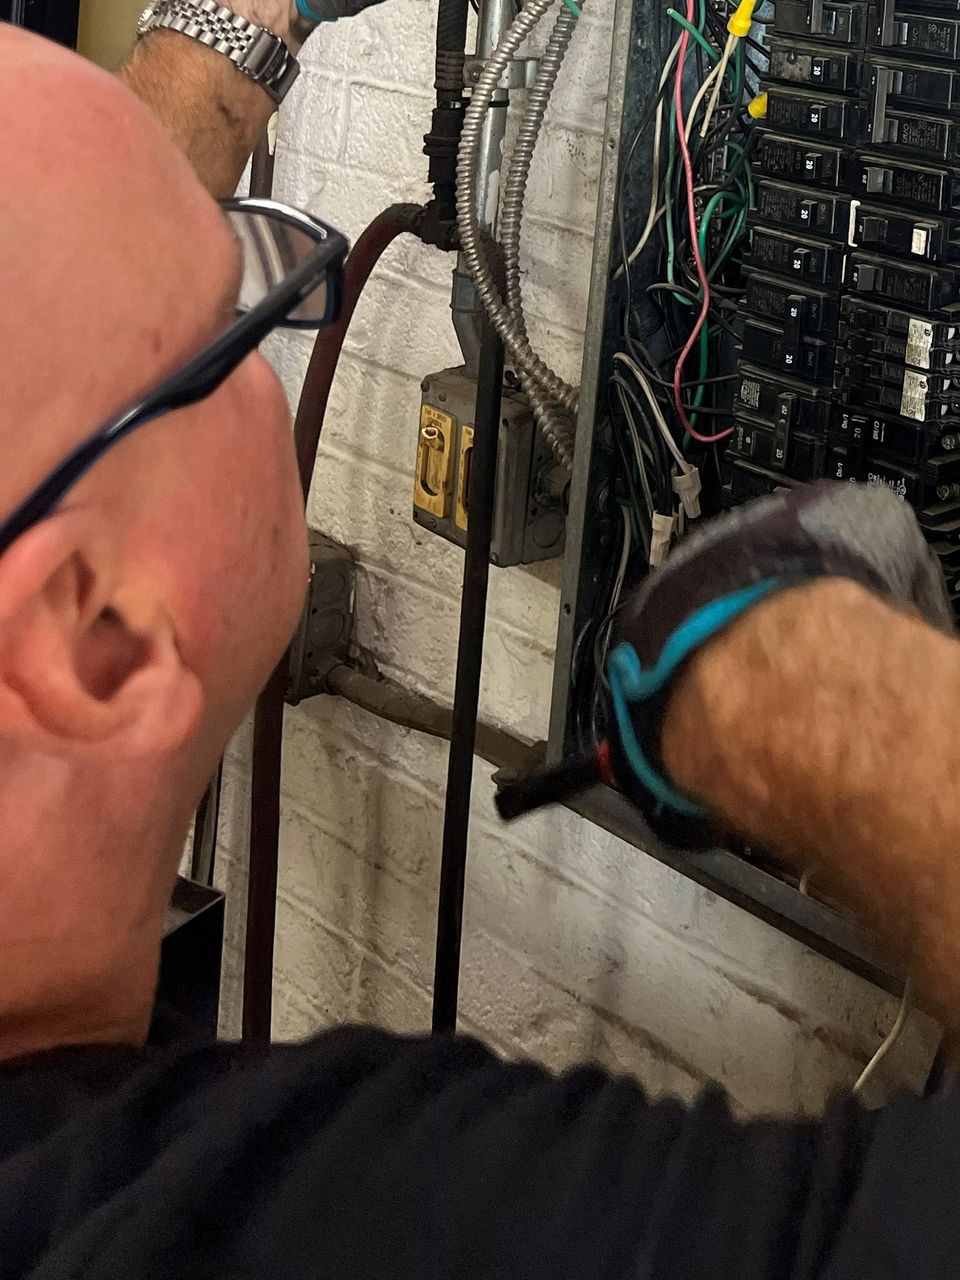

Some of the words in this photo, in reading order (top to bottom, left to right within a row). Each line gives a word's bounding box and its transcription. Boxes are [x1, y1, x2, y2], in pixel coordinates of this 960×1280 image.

[813, 66, 821, 76] 20
[811, 113, 818, 123] 20
[805, 160, 813, 170] 20
[801, 210, 808, 219] 20
[793, 259, 801, 269] 20
[791, 308, 797, 317] 20
[785, 355, 792, 364] 20
[854, 428, 861, 438] 20
[776, 449, 783, 459] 20
